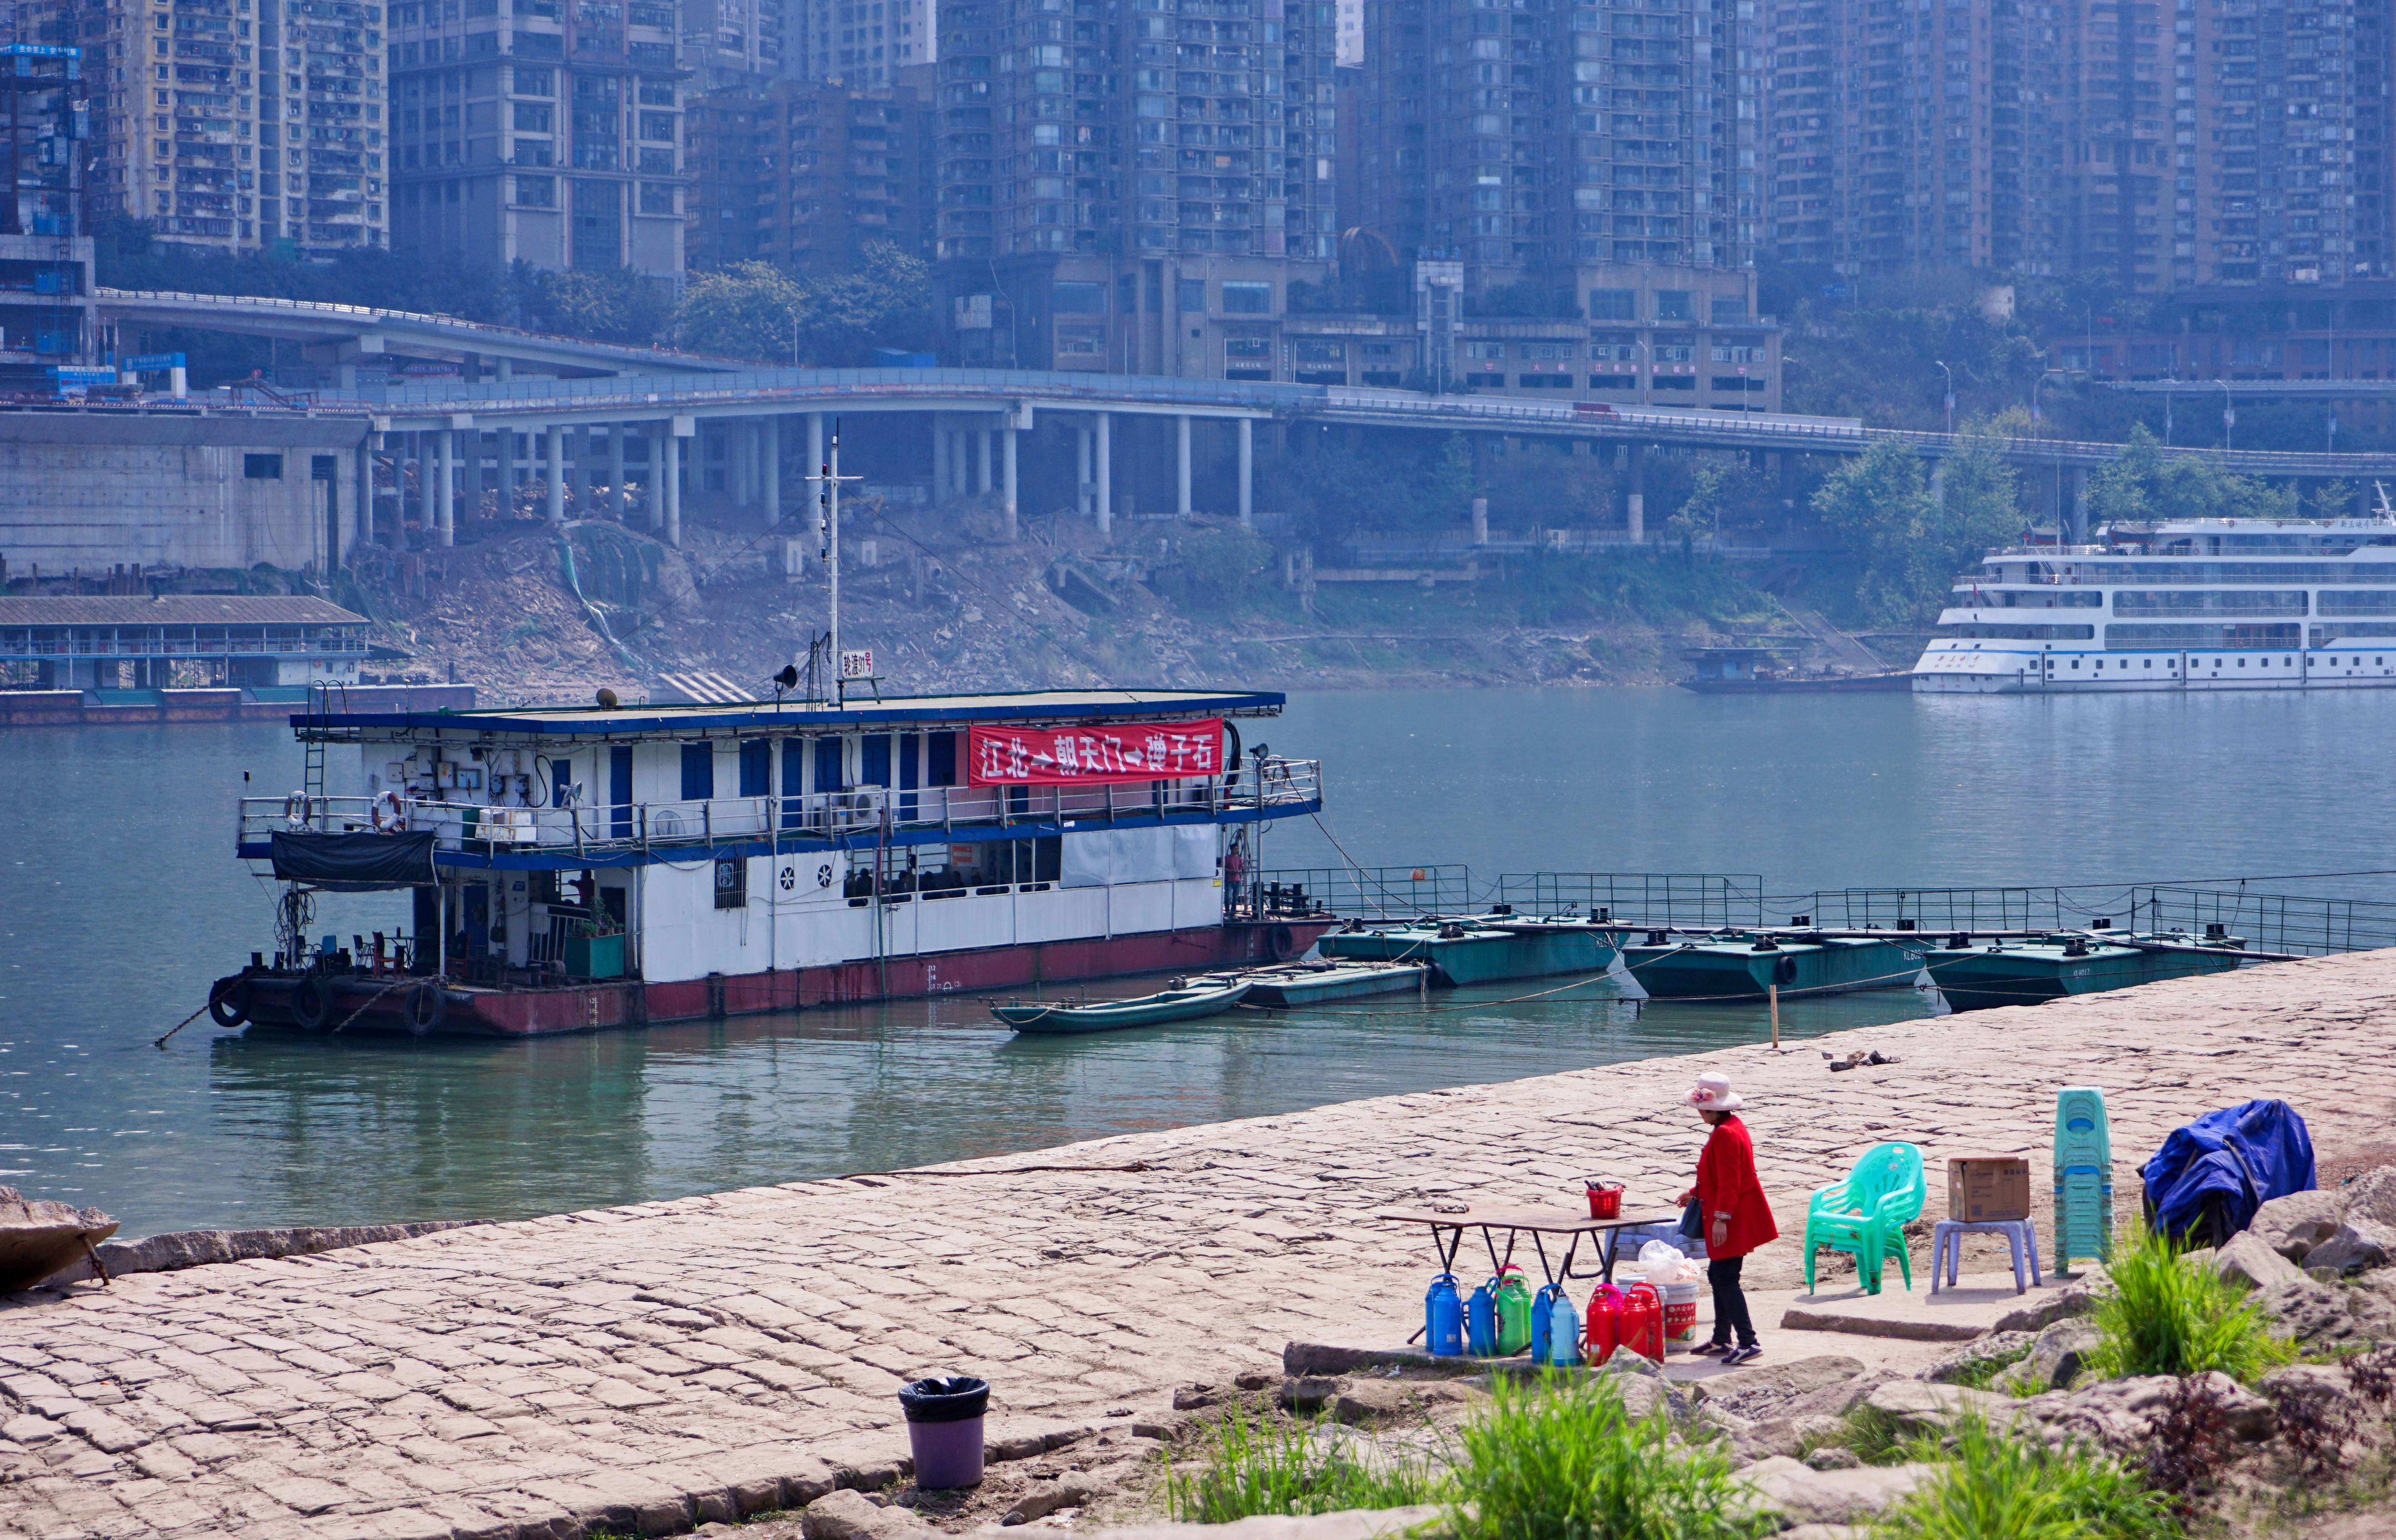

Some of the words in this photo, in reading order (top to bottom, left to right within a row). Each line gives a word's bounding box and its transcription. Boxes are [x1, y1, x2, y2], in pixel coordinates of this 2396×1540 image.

[843, 652, 872, 676] 轮渡91号
[1054, 734, 1126, 776] 朝天门
[1146, 733, 1213, 771] 弹子石
